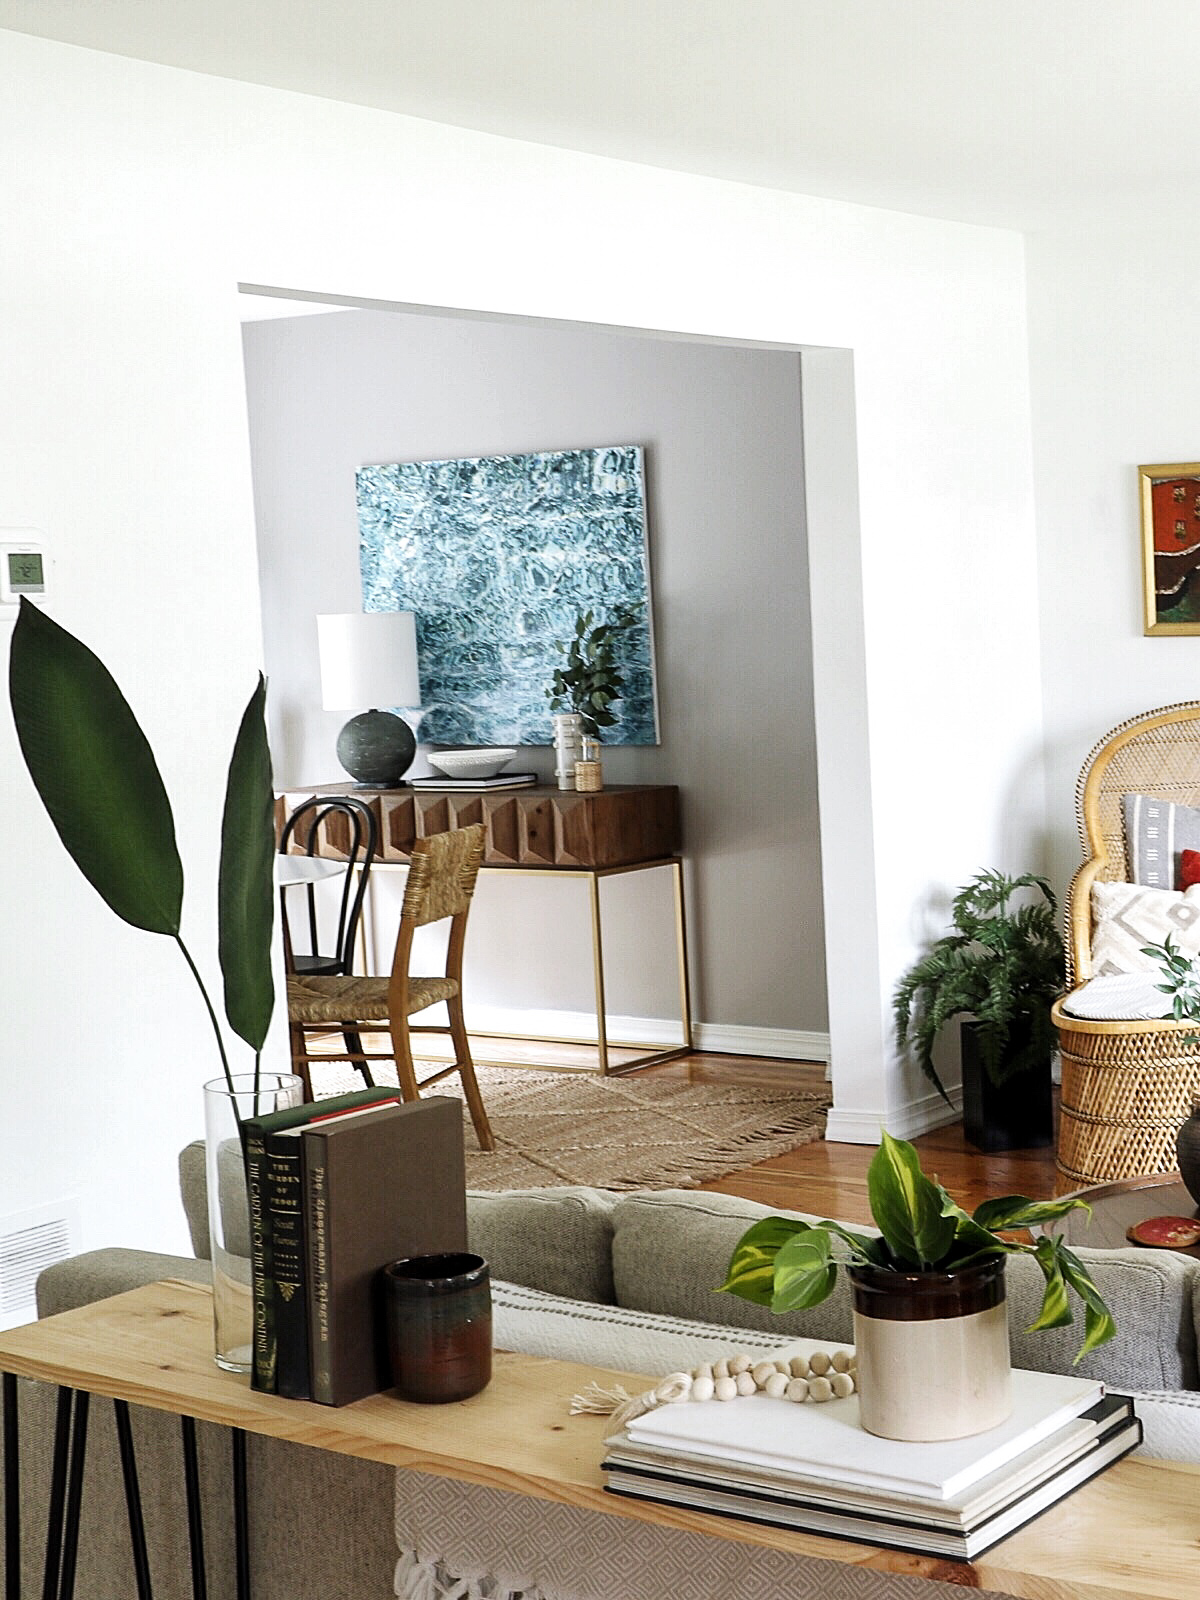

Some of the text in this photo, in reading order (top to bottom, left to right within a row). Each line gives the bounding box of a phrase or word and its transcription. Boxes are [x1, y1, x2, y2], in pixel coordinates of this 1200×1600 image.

[249, 1162, 260, 1178] THE
[272, 1163, 291, 1171] THE
[267, 1173, 300, 1183] BURDEN
[250, 1183, 262, 1229] GARDEN
[271, 1196, 297, 1206] PROOF
[253, 1232, 264, 1247] OF
[254, 1252, 264, 1268] THE
[315, 1167, 329, 1342] The Zimmermann Telegram
[256, 1301, 268, 1354] CONTINIS
